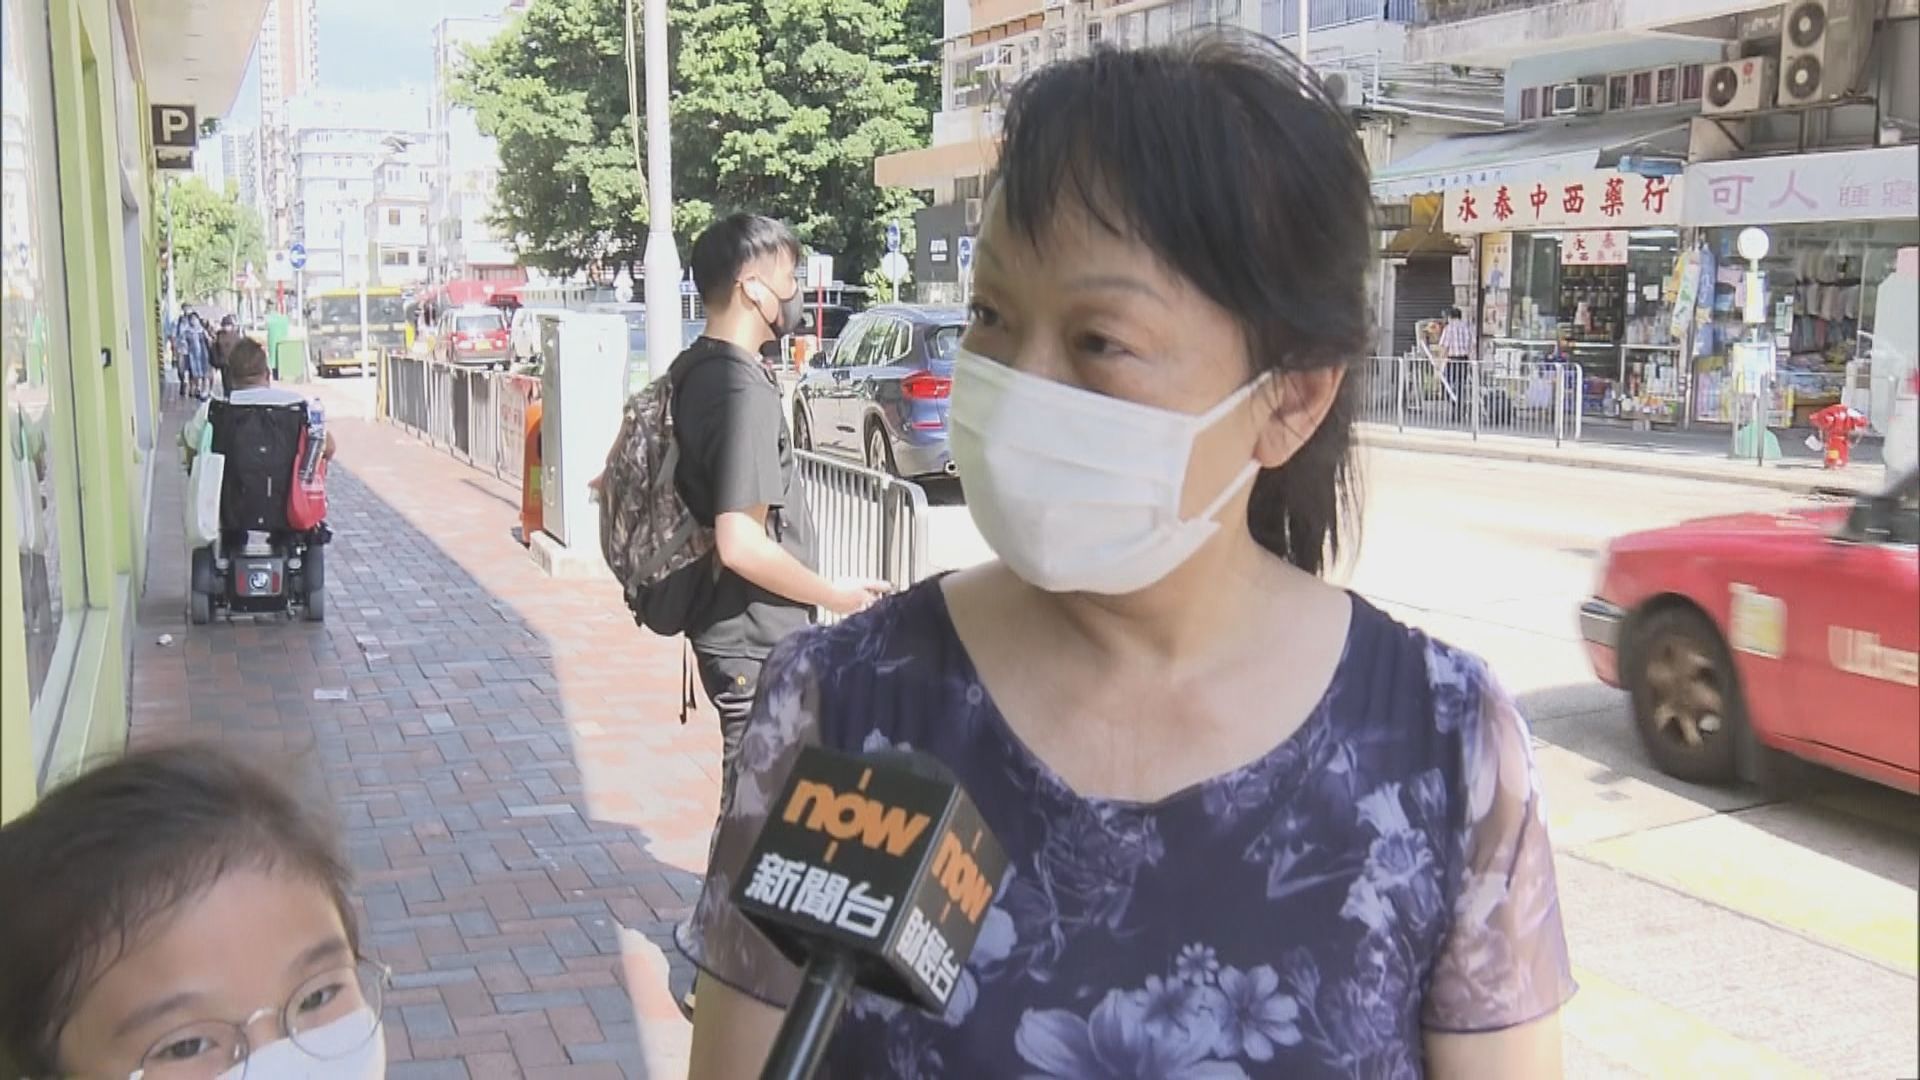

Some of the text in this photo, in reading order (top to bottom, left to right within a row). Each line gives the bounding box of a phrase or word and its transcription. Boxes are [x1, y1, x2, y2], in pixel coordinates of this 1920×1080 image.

[162, 109, 189, 143] P
[1457, 175, 1669, 223] 永泰中西藥行
[1709, 169, 1818, 215] 可人
[783, 779, 930, 857] now
[744, 852, 894, 938] 新聞台
[931, 830, 993, 923] now
[896, 906, 960, 1004] 財經台
